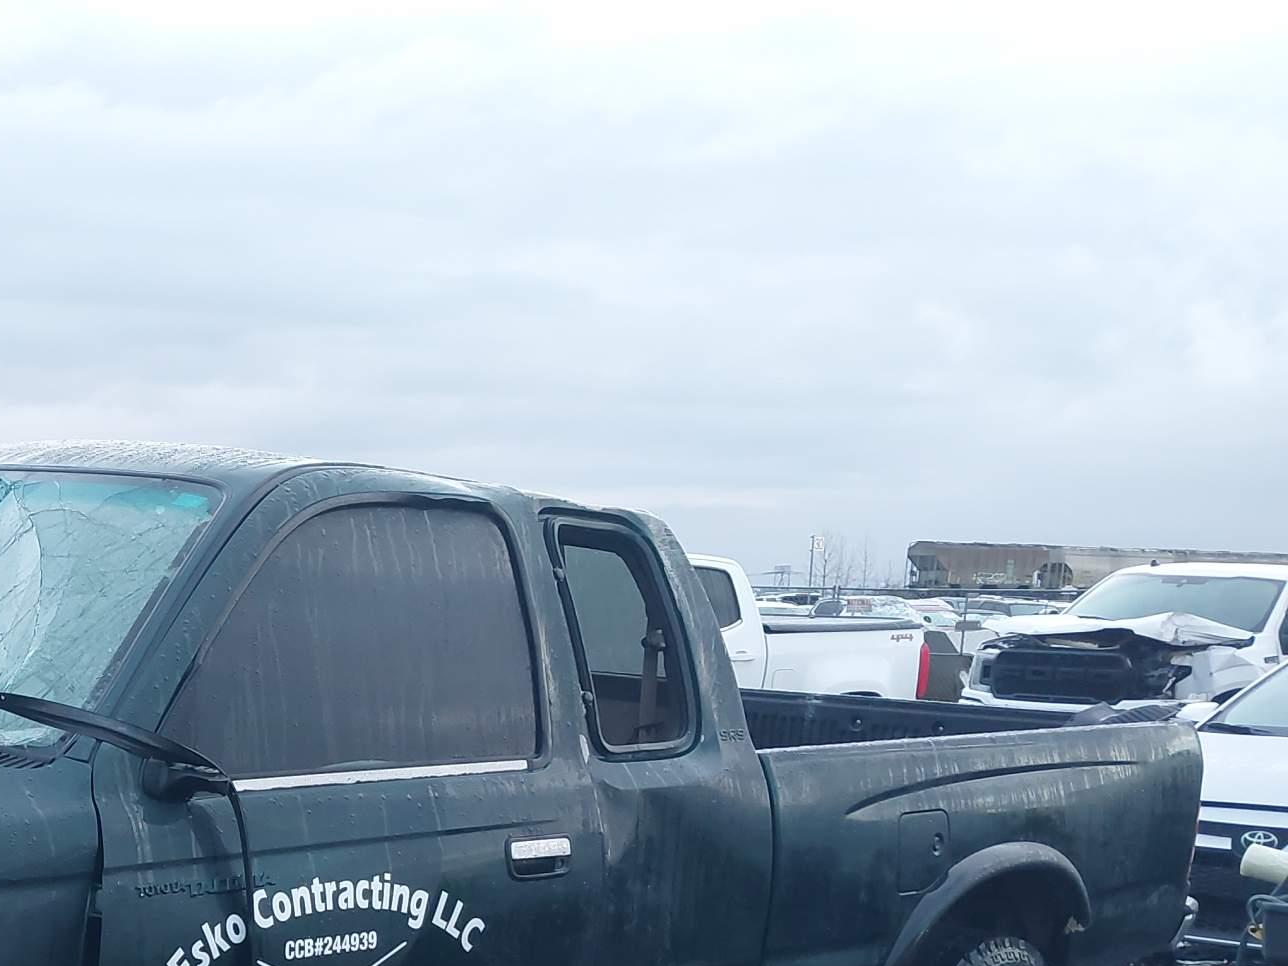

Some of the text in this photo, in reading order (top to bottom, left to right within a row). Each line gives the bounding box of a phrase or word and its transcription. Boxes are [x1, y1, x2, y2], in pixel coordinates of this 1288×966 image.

[252, 872, 430, 930] Contracting
[430, 890, 487, 954] LLC
[284, 930, 378, 960] CCB#244939
